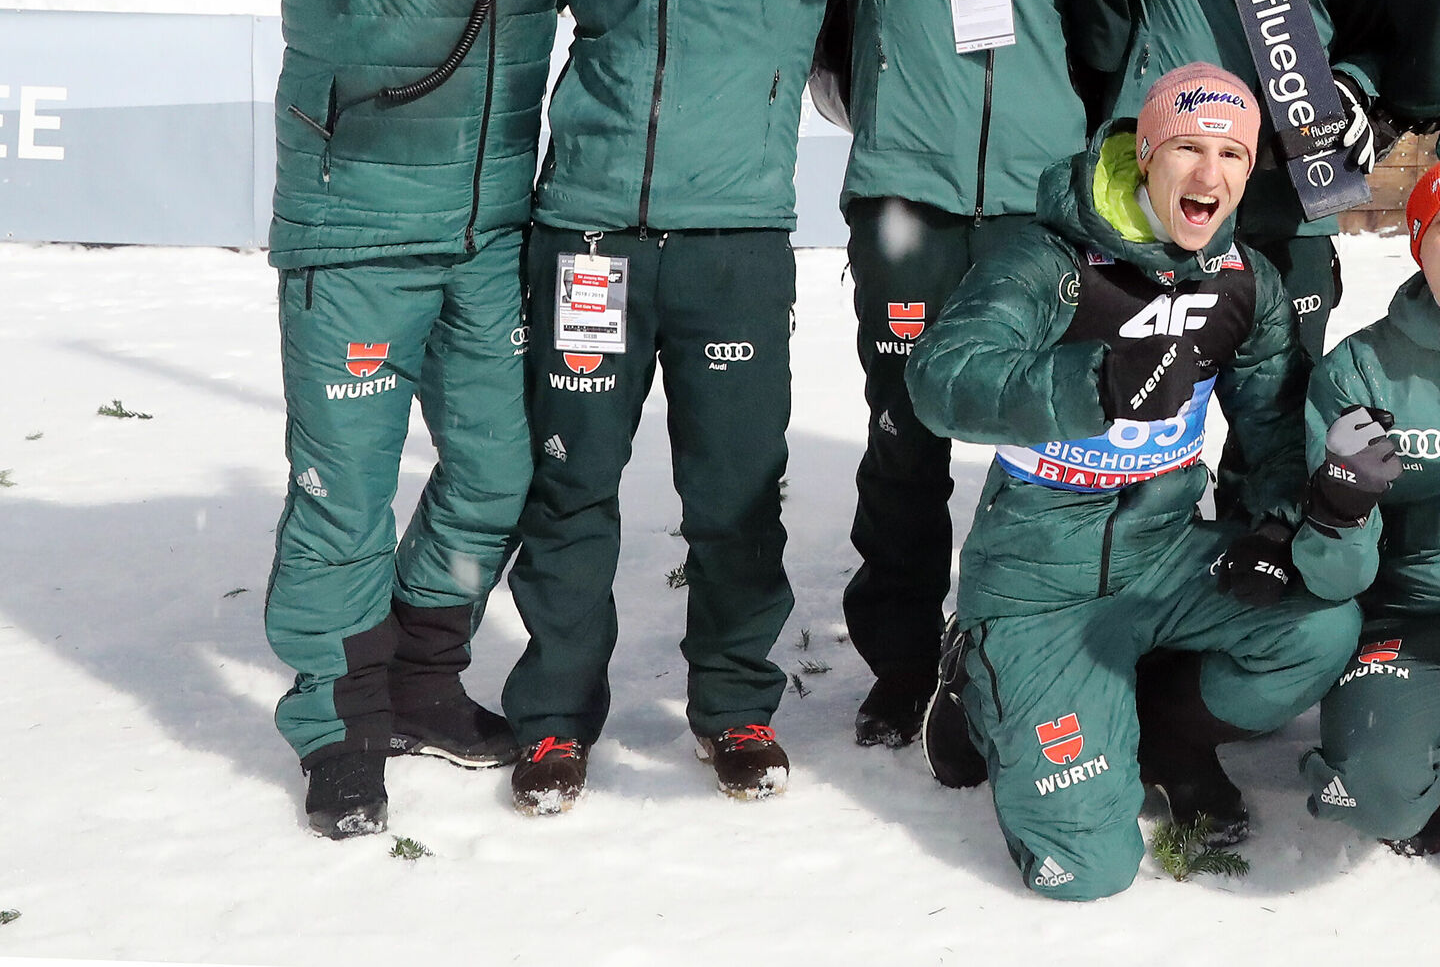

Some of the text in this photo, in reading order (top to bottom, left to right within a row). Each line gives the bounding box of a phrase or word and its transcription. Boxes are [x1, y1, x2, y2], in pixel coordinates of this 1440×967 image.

[1174, 86, 1248, 117] Manner
[1119, 293, 1219, 338] 4F
[709, 361, 727, 371] Audi
[1129, 342, 1179, 410] ziener
[325, 374, 397, 400] WÜRTH
[549, 373, 616, 393] WÜRTH
[1328, 462, 1357, 484] SEIZ
[1403, 463, 1423, 472] udi
[1338, 660, 1410, 687] WÜRTH
[1034, 755, 1109, 797] WÜRTH
[1321, 792, 1357, 808] adidas
